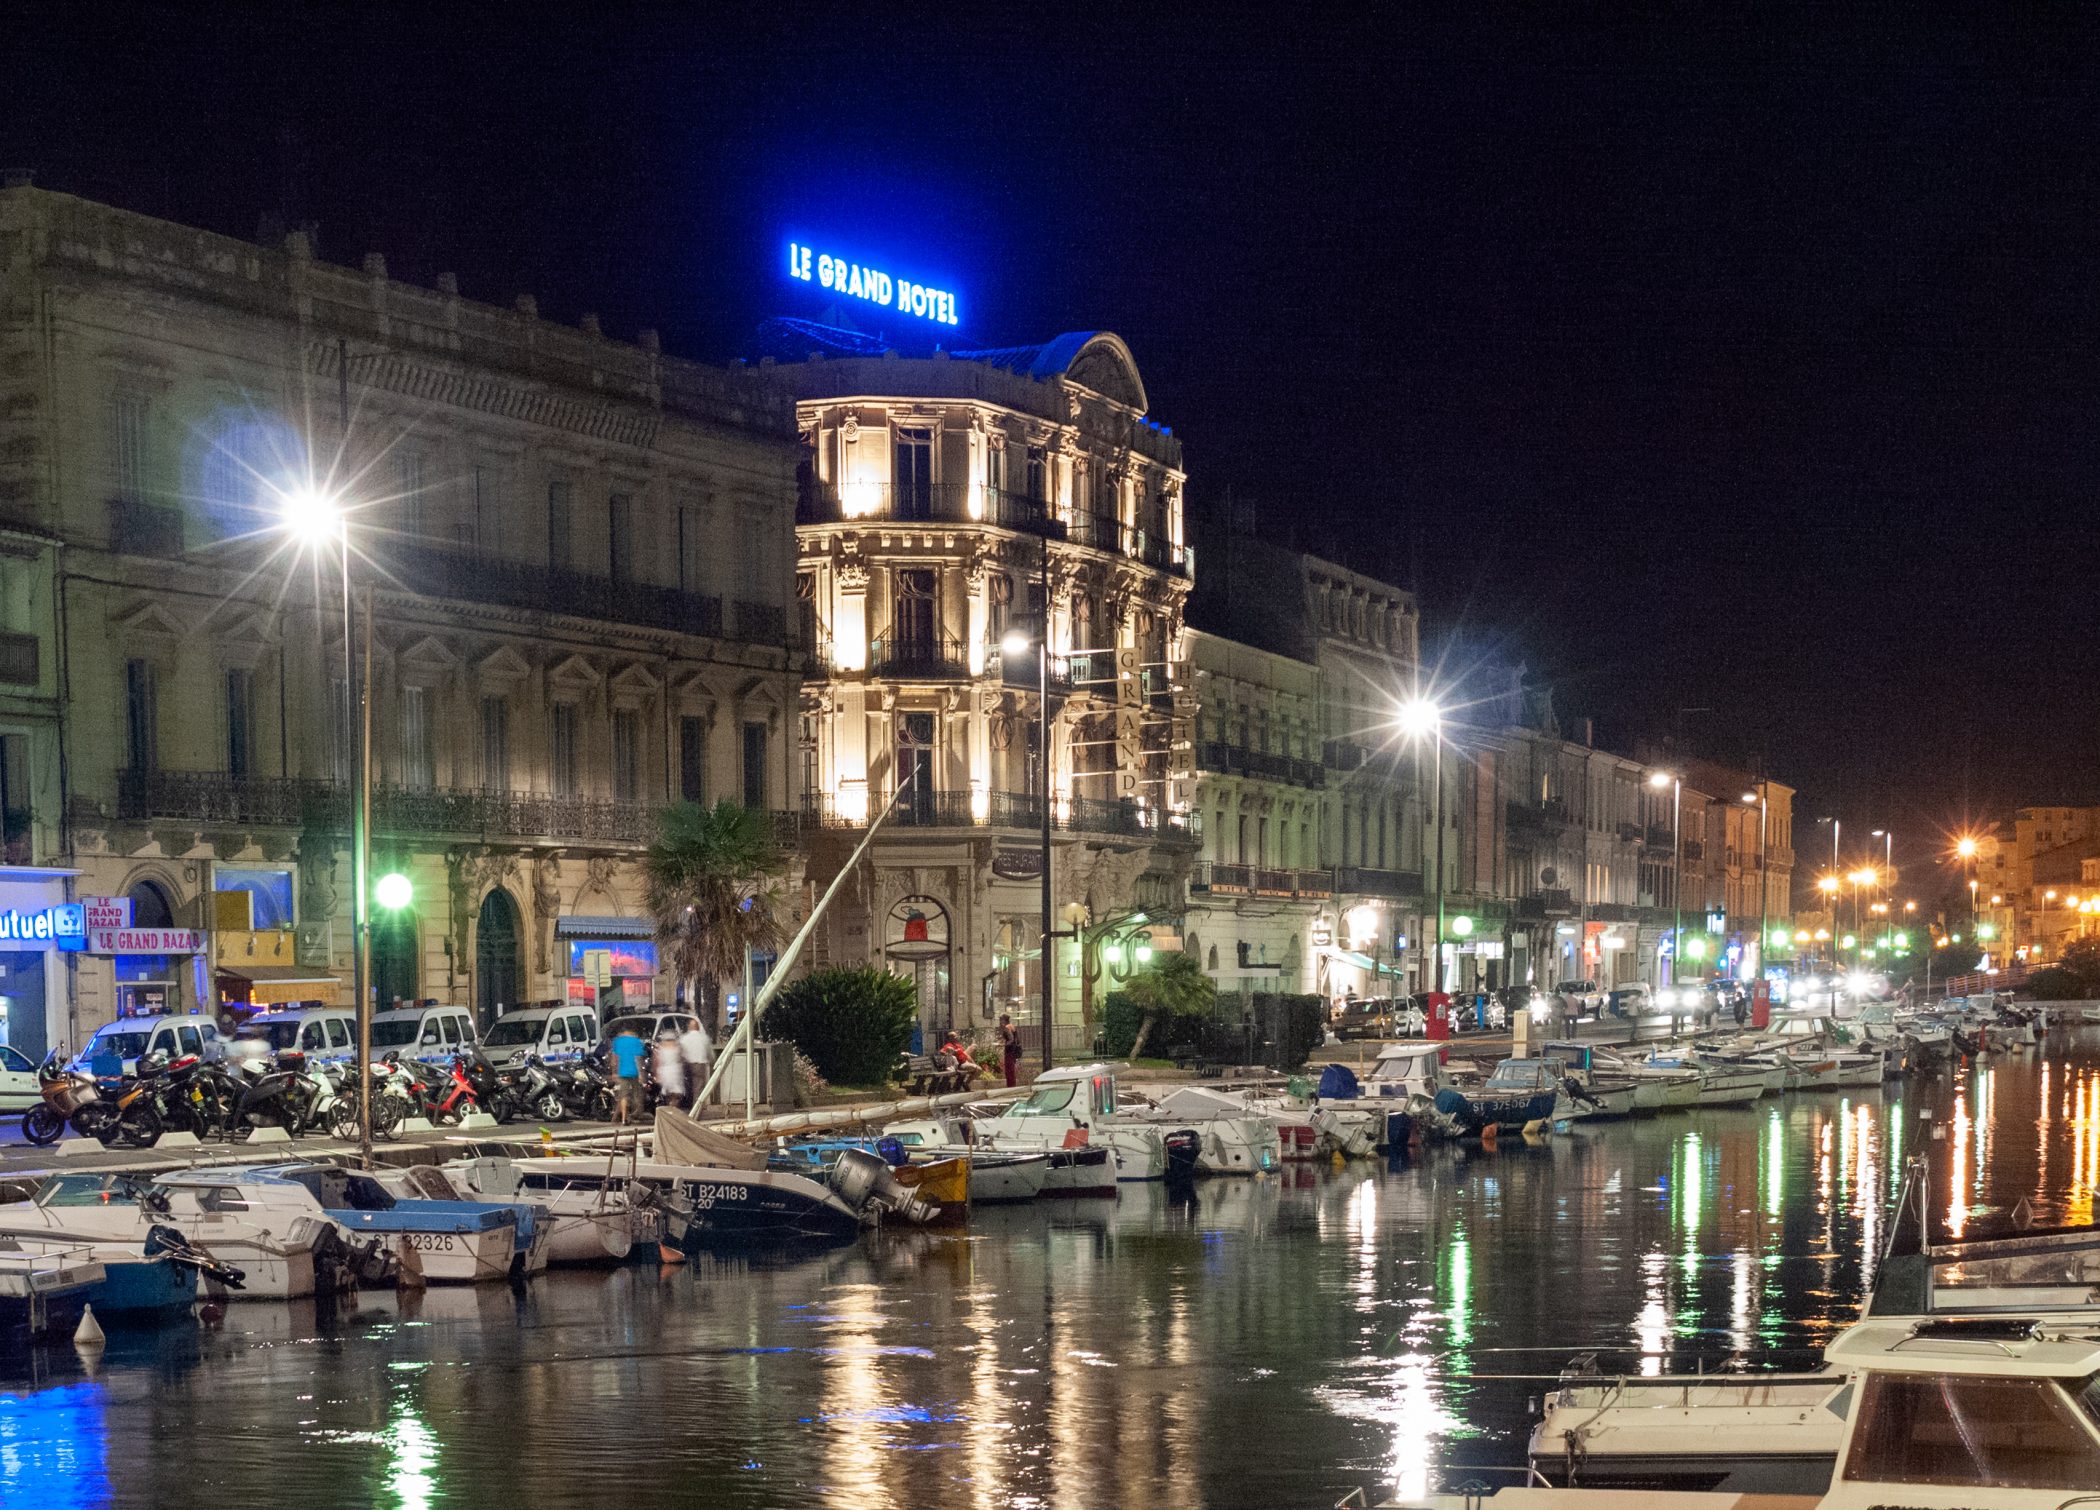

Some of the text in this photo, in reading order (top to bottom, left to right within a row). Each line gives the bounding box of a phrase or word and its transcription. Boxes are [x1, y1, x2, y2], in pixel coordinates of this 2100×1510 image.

[790, 243, 958, 325] LE GRAND HOTEL
[1121, 652, 1136, 790] GRAND
[1178, 665, 1193, 798] HOTEL
[98, 898, 111, 907] LE
[99, 933, 113, 949] LE
[118, 933, 158, 949] GRAND
[1473, 1103, 1484, 1112] ST
[681, 1184, 747, 1200] ST B24183
